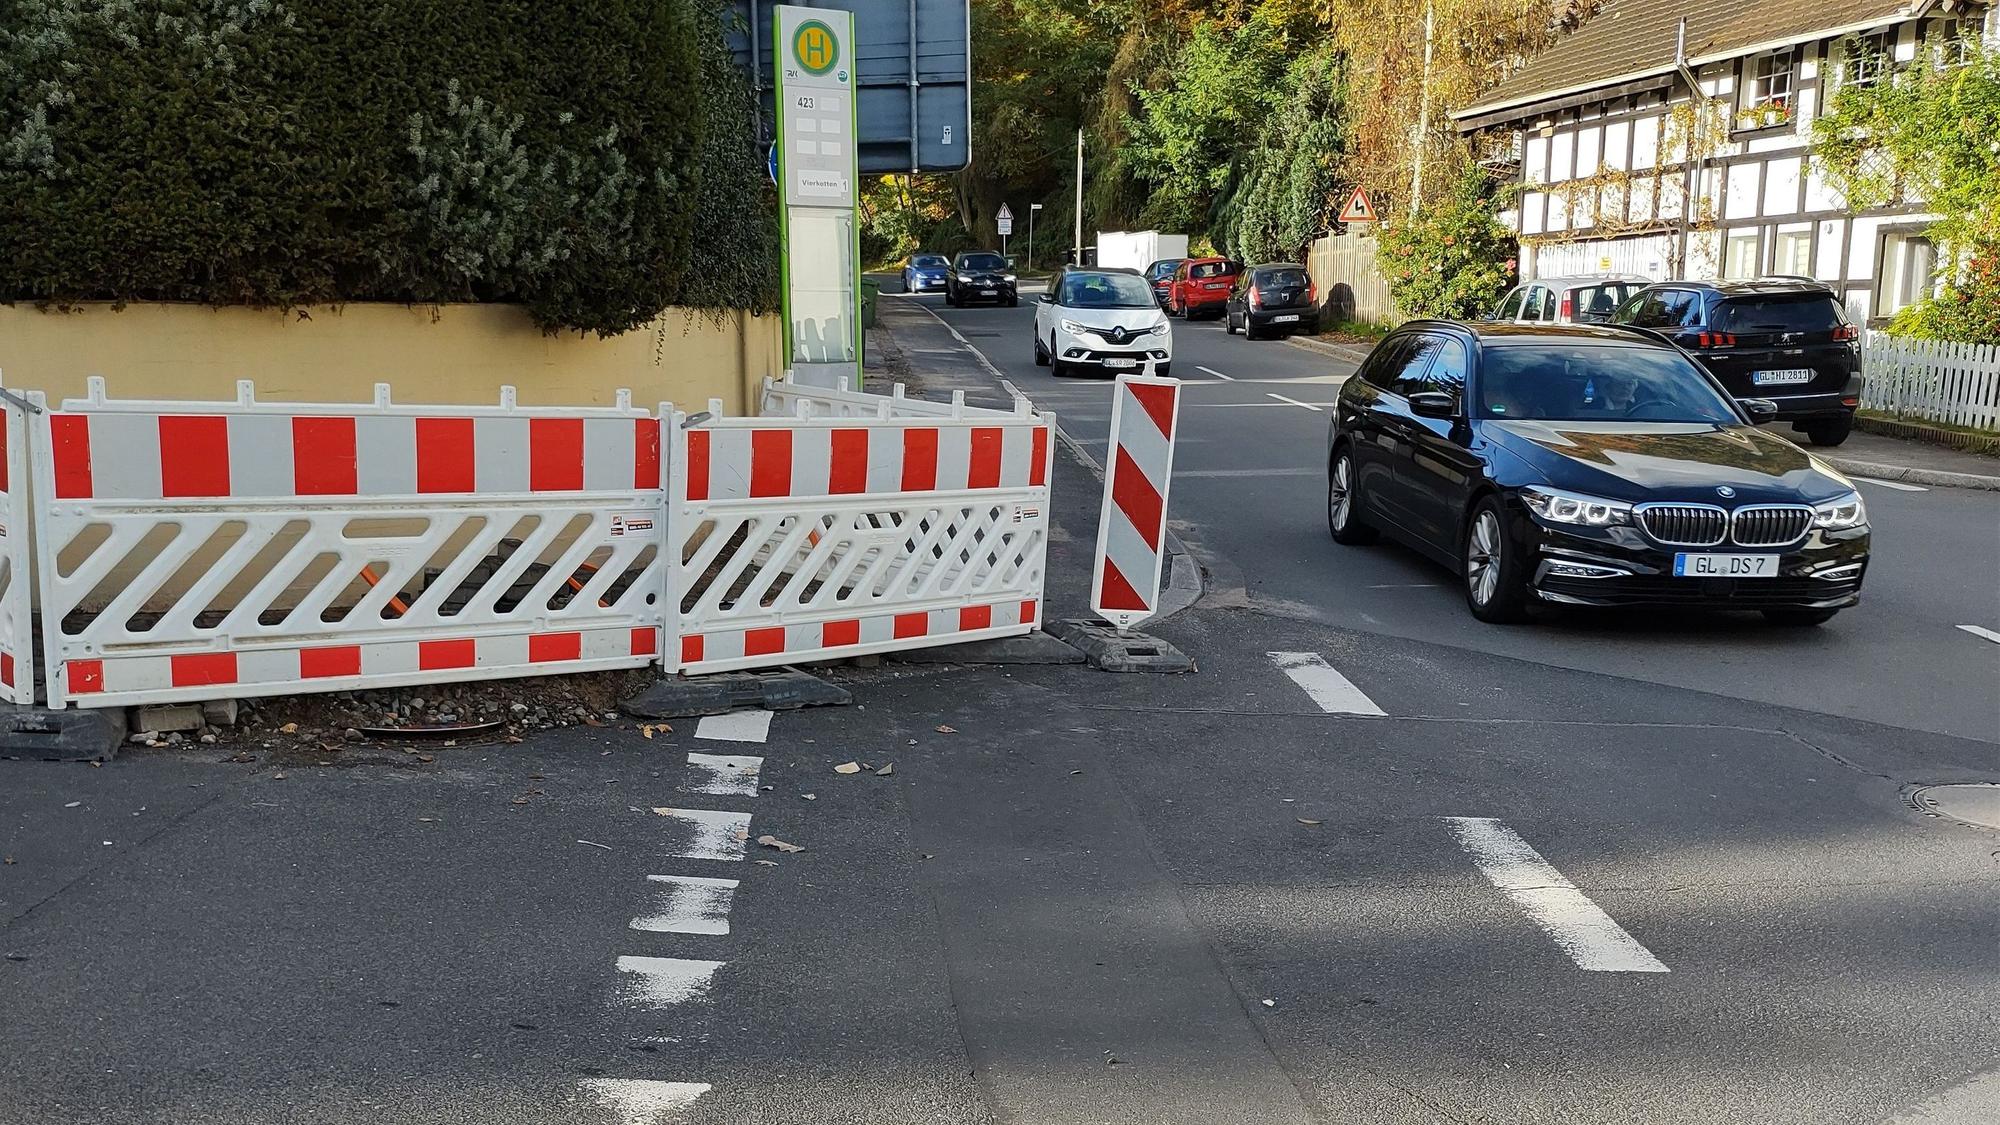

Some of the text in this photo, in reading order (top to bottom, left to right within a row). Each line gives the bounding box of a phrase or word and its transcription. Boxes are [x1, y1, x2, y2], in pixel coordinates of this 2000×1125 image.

[806, 32, 825, 64] H
[797, 96, 814, 109] 423
[842, 180, 847, 191] 1
[1759, 371, 1770, 381] GL
[1788, 370, 1808, 380] 2811
[1696, 557, 1766, 574] GL DS 7
